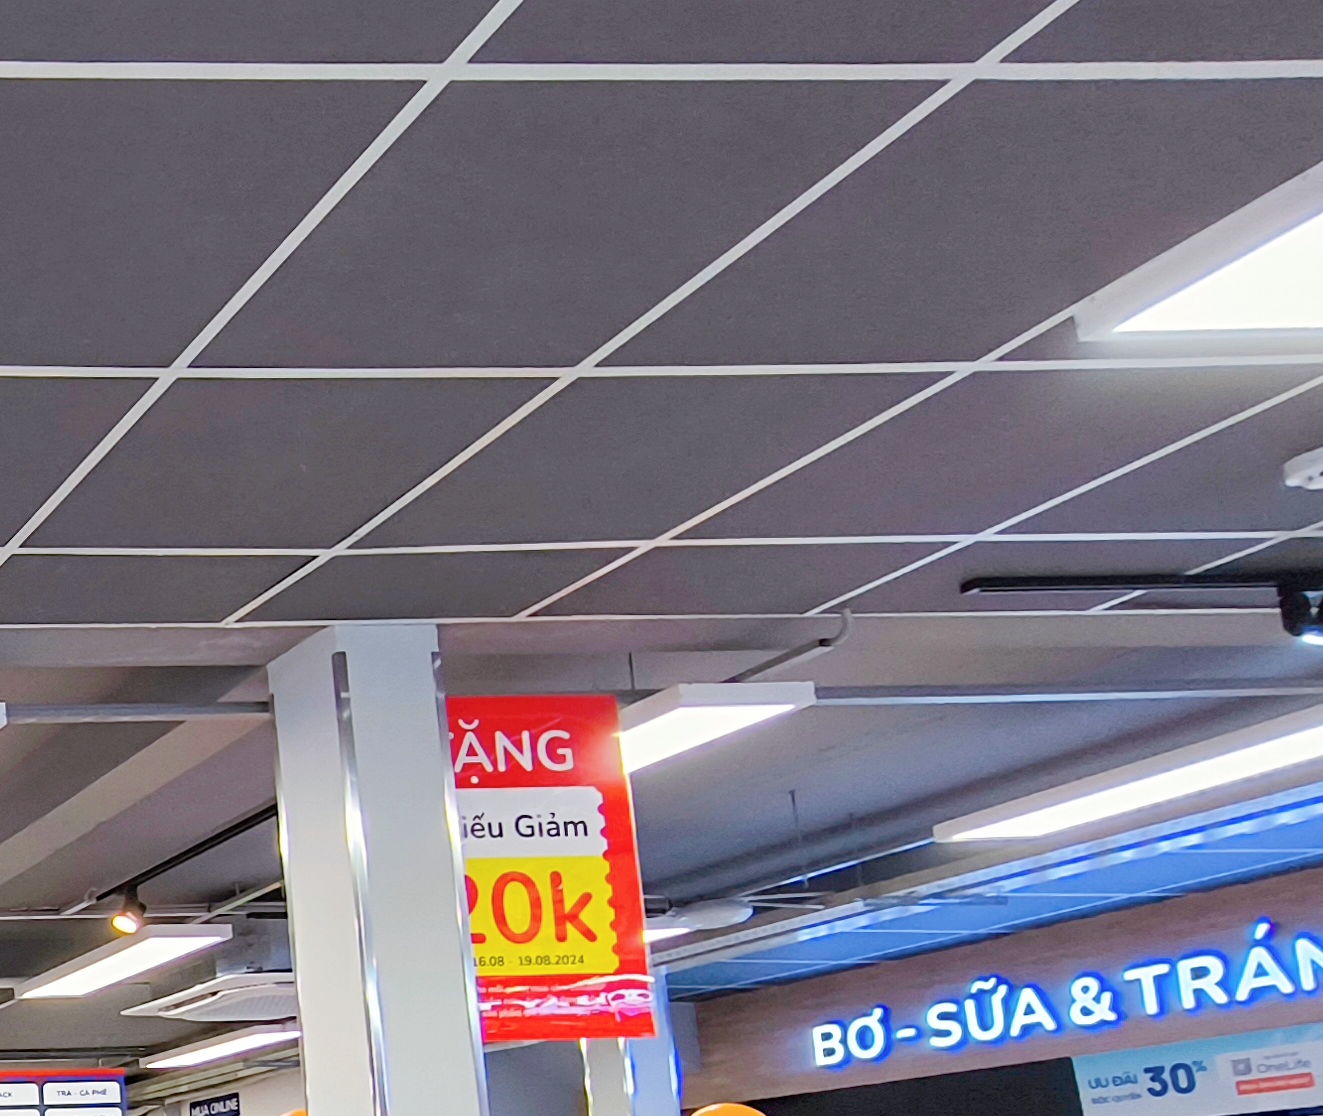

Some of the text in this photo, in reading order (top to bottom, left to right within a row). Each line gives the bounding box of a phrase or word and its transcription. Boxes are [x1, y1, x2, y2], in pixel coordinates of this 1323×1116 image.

[450, 719, 574, 784] ẶNG
[515, 813, 588, 837] Giảm
[518, 954, 585, 966] 19.08.2024
[1068, 977, 1117, 1026] &
